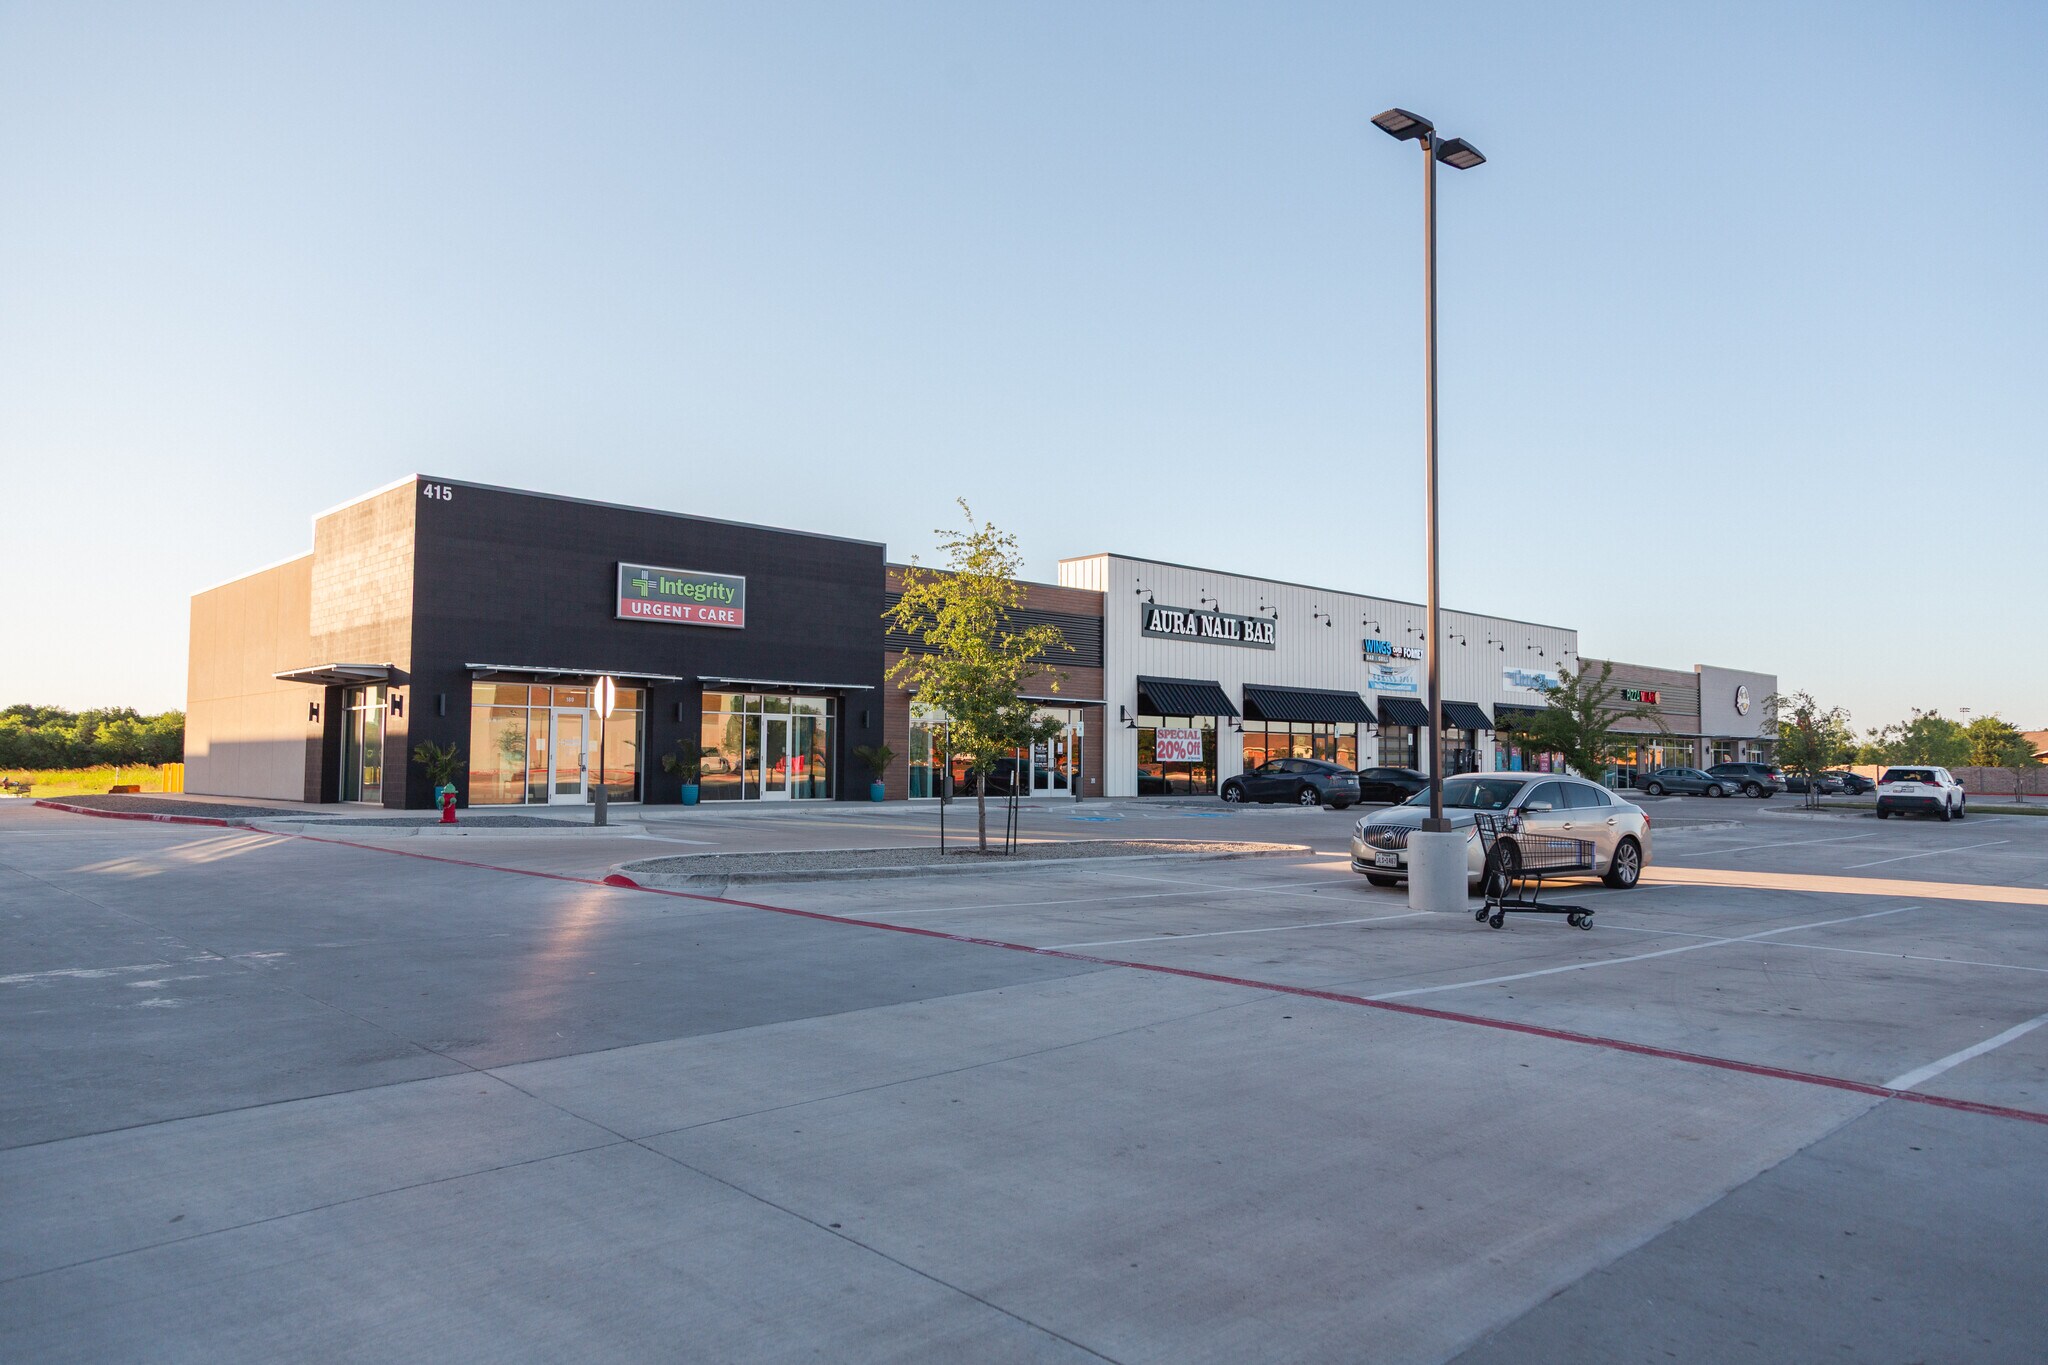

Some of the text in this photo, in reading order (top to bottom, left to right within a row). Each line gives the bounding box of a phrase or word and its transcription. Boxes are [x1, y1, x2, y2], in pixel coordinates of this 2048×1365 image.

[423, 484, 453, 501] 415
[660, 576, 735, 604] Integrity
[631, 602, 735, 622] URGENT CARE
[1149, 609, 1275, 645] AURA NAIL BAR
[1365, 639, 1392, 656] WINGS
[1157, 729, 1201, 740] SPECIAL
[1157, 740, 1201, 760] 20% Off
